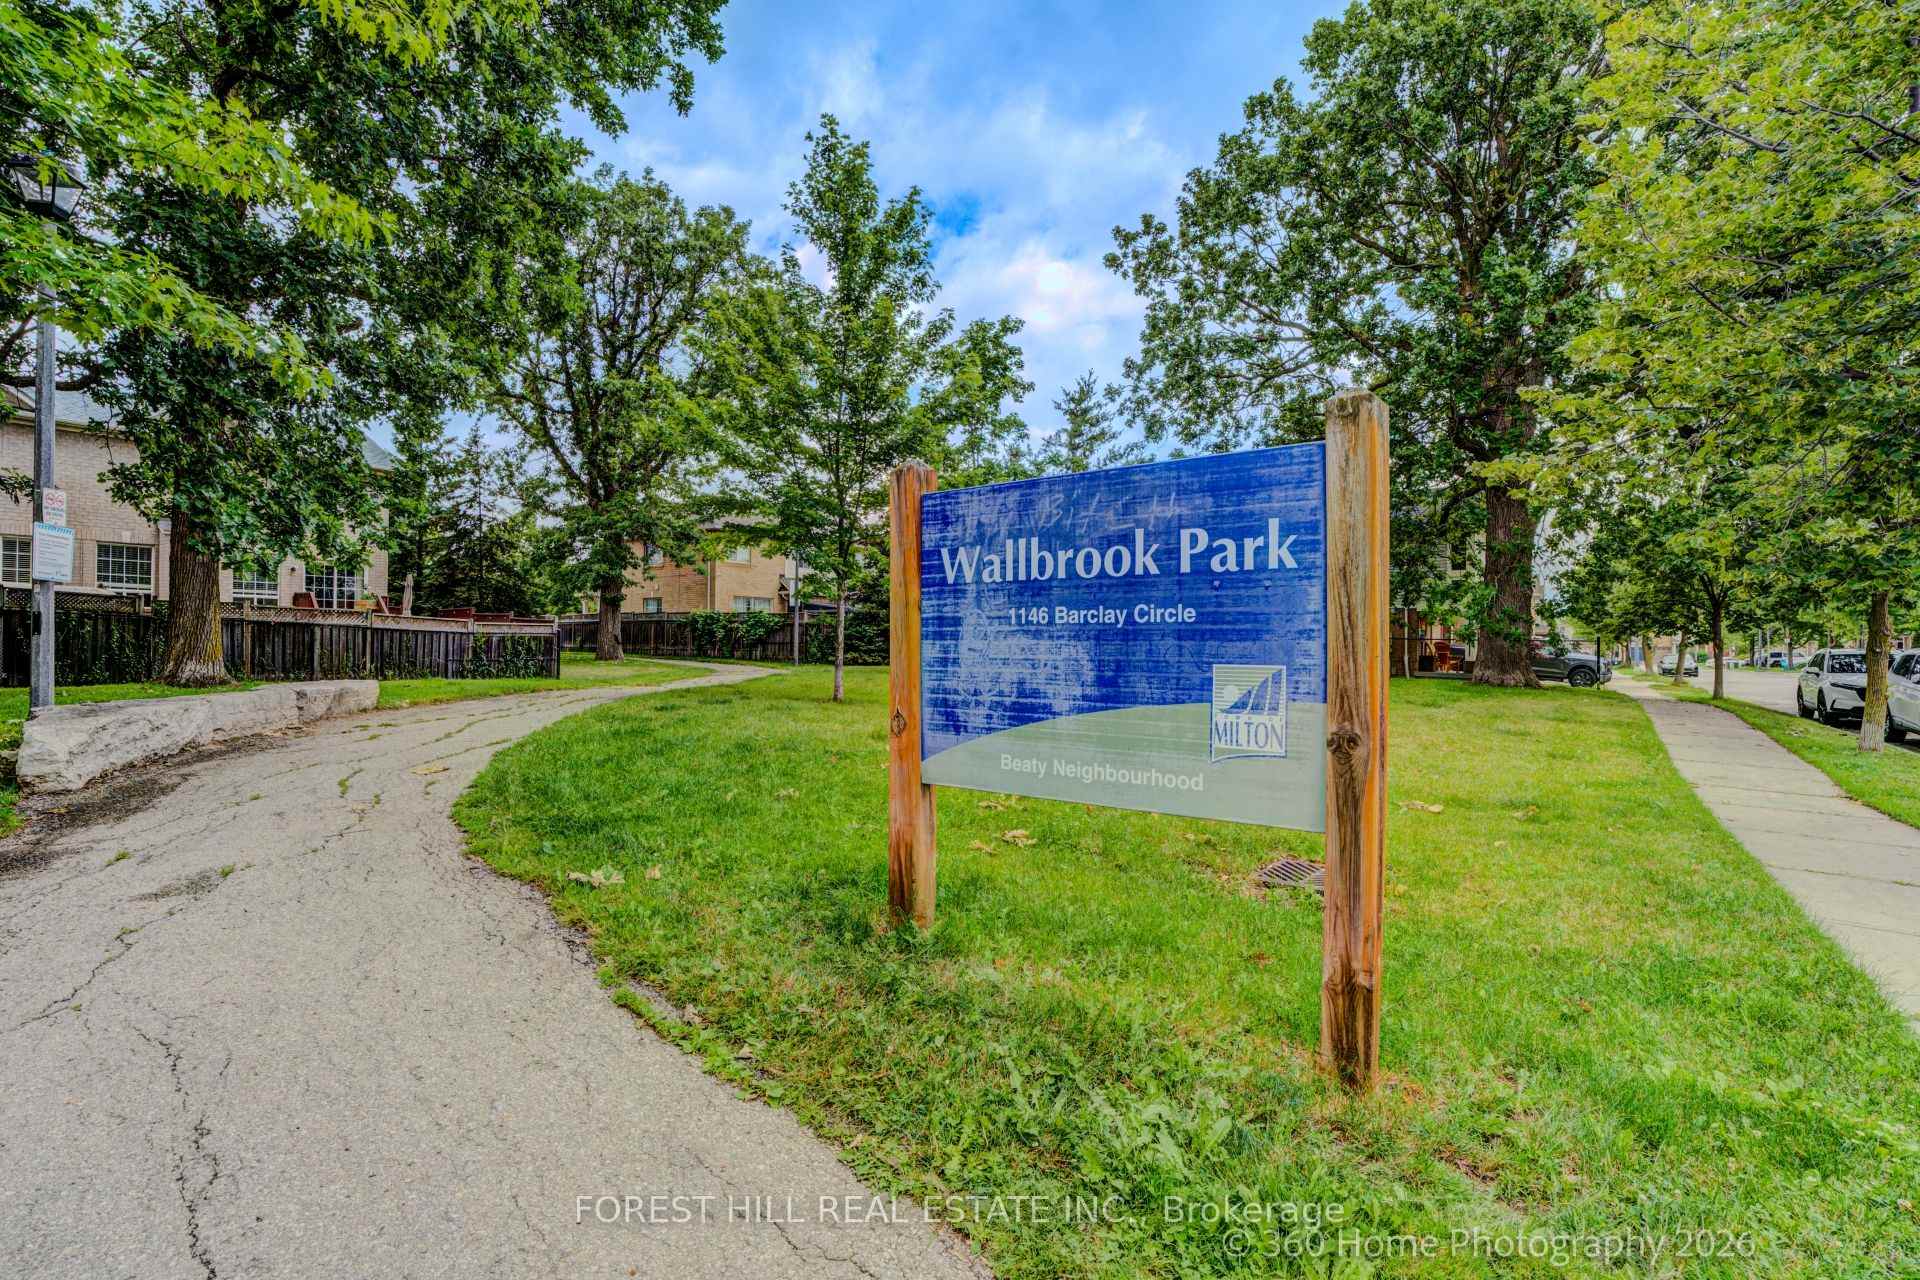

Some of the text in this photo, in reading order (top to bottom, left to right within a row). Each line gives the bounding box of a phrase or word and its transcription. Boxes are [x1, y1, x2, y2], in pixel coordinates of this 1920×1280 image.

[940, 517, 1299, 585] Wallbrook Park
[1009, 603, 1197, 628] 1146 Barclay Circle
[1215, 719, 1284, 751] MILTON
[1000, 753, 1205, 792] Beaty Neighbourhood
